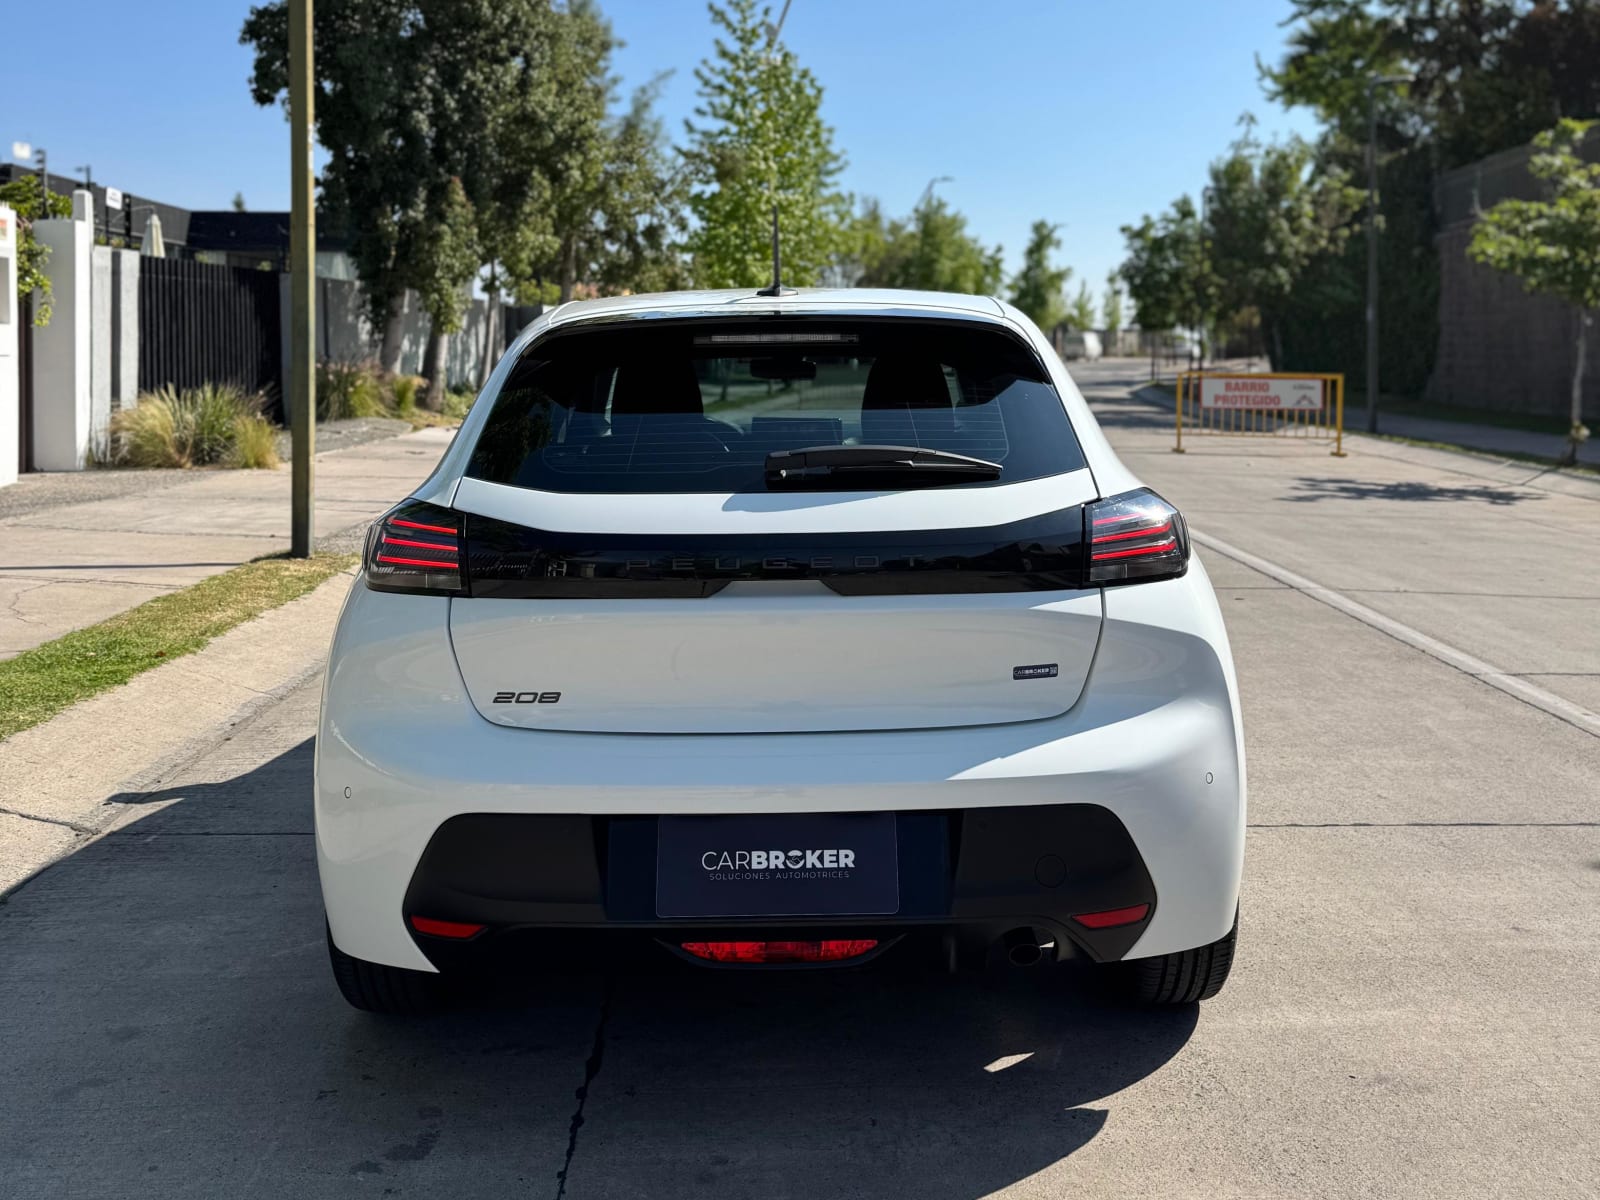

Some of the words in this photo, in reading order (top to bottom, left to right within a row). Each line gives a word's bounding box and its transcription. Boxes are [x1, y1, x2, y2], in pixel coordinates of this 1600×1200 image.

[1225, 381, 1270, 393] BARRIO
[1213, 394, 1281, 406] PROTEGIDO
[626, 554, 924, 571] PEUGEOT
[492, 691, 561, 703] 208
[701, 849, 855, 871] CARBROKER
[709, 872, 770, 881] SOLUCIONES
[775, 870, 850, 880] AUTOMOTRICES
